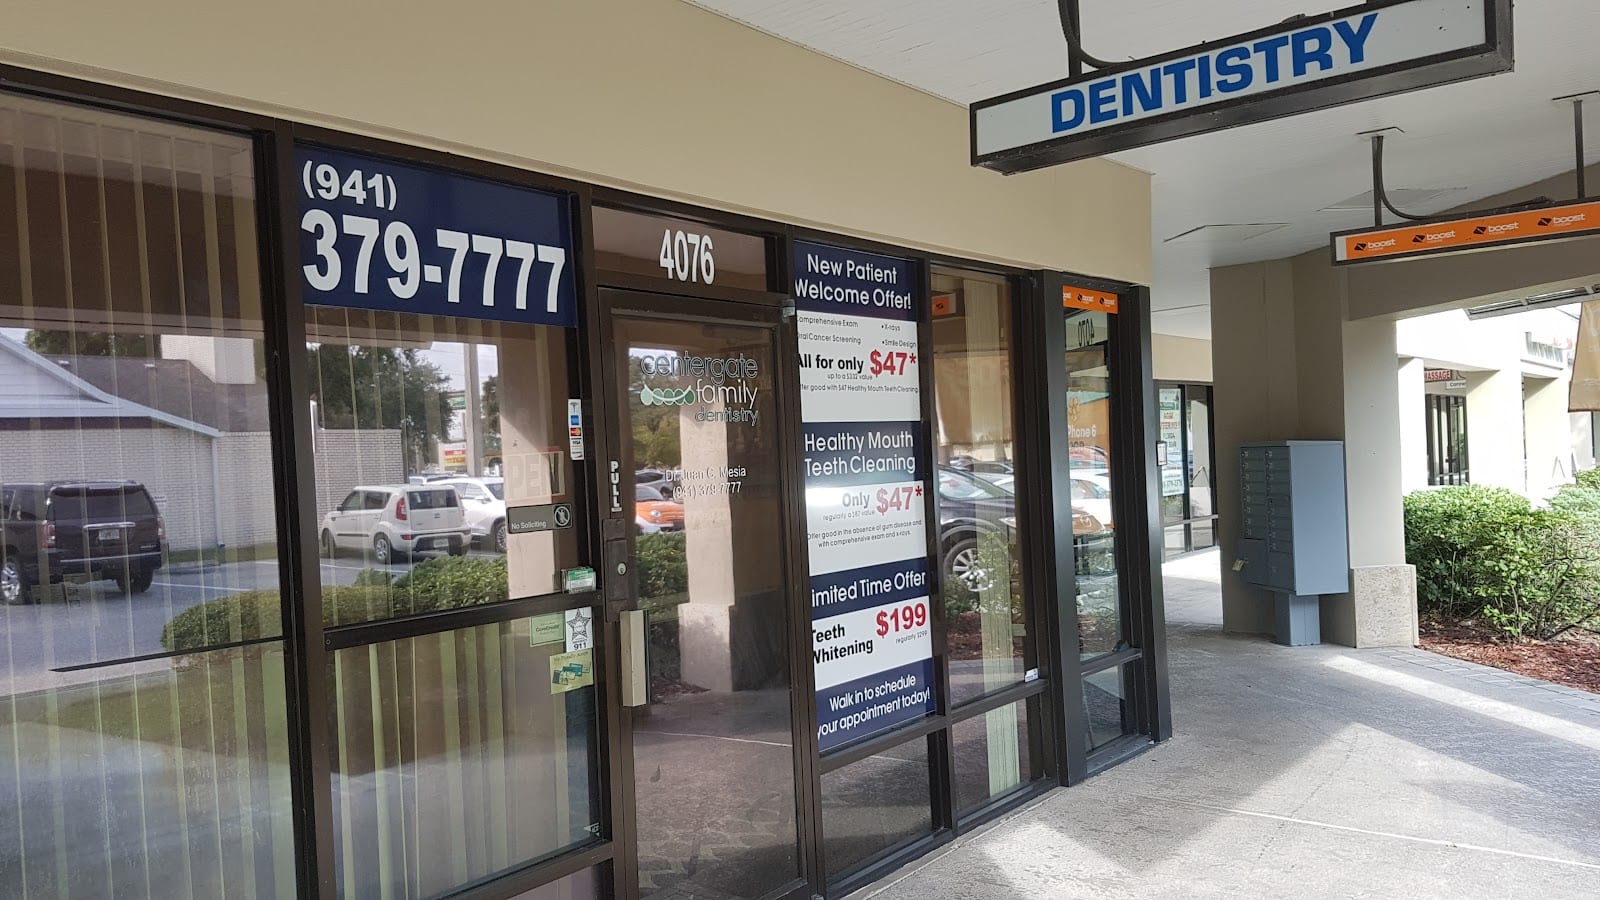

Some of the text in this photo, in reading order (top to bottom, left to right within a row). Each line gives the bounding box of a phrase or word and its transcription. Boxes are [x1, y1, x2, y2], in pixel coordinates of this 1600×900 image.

[1051, 12, 1378, 133] DENTISTRY
[302, 160, 397, 211] (941)
[1488, 222, 1519, 233] boost
[1553, 213, 1586, 225] boost
[1367, 238, 1396, 249] boost
[1426, 230, 1456, 241] boost
[300, 209, 566, 313] 379-7777
[659, 229, 715, 285] 4076
[807, 253, 897, 284] New Patient
[795, 278, 911, 310] Welcome Offer!
[798, 316, 858, 328] omprehensive Exam
[809, 332, 832, 342] Cancer
[833, 335, 861, 344] Screening
[899, 340, 917, 348] Design
[640, 351, 758, 386] centergate
[815, 354, 834, 370] for
[837, 356, 864, 374] only
[695, 379, 758, 409] family
[810, 384, 826, 392] good
[847, 384, 867, 393] Healthy
[897, 386, 919, 394] Cleaning
[695, 407, 759, 427] dentistry
[1067, 424, 1097, 438] Phone 6
[804, 431, 914, 453] Healthy Mouth
[719, 465, 747, 479] Mesia
[804, 454, 916, 477] Teeth Cleaning
[610, 460, 620, 507] PULL
[842, 491, 870, 509] Only
[511, 520, 547, 530] No Soliciting
[822, 530, 836, 539] good
[853, 525, 875, 534] absence
[882, 523, 893, 531] gum
[818, 540, 829, 548] with
[830, 535, 870, 546] comprehensive
[871, 533, 885, 541] exam
[886, 531, 895, 539] and
[811, 571, 926, 607] imited Time Offer
[876, 603, 926, 639] $199
[573, 642, 587, 650] 911
[829, 674, 917, 711] Walk in to schedule
[839, 695, 901, 731] appointment
[902, 687, 931, 709] today!
